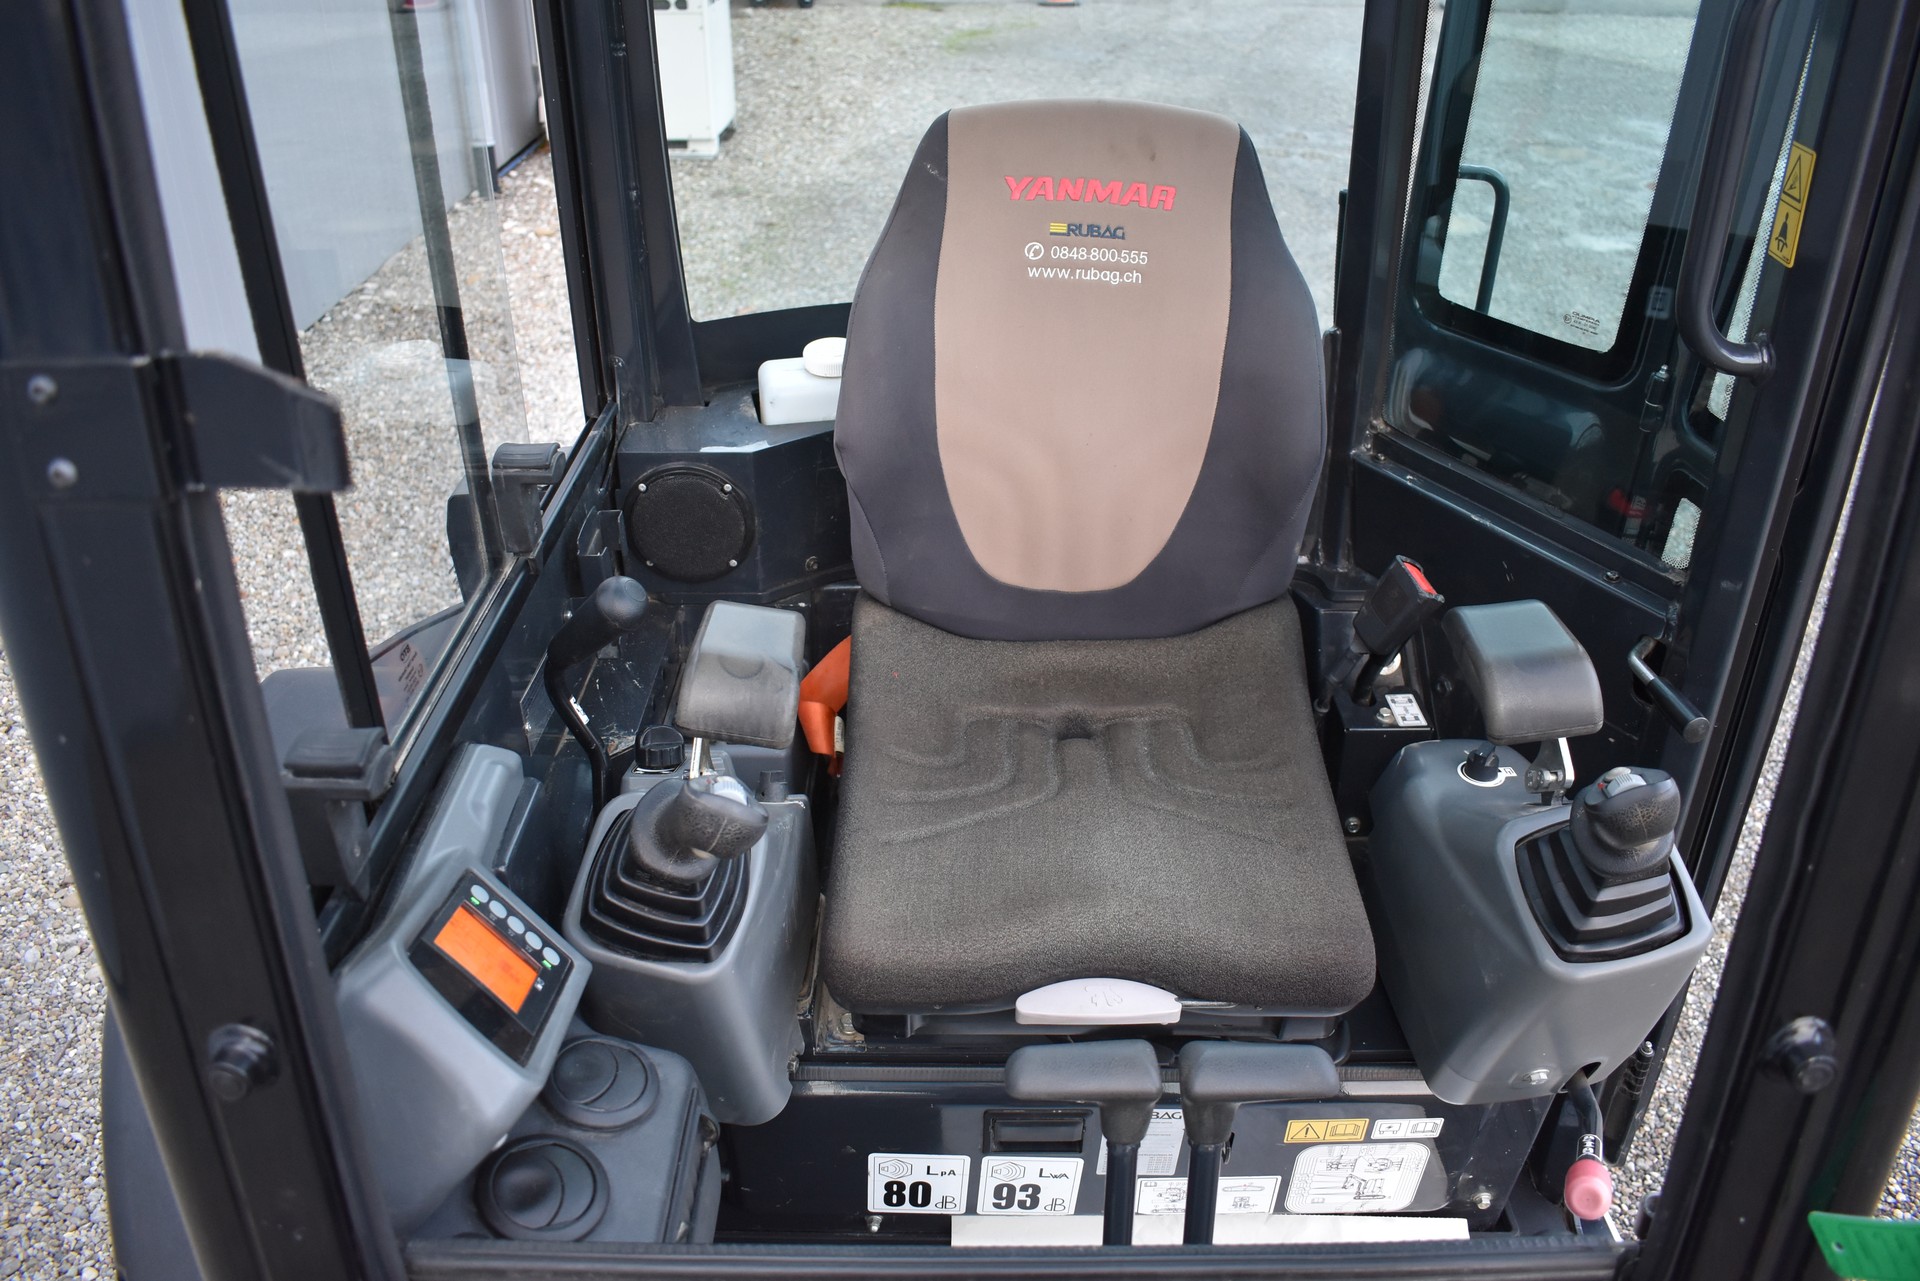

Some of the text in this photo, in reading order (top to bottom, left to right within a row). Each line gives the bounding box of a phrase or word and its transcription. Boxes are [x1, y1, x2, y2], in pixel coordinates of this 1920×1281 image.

[1004, 175, 1177, 211] YANMAR
[1066, 223, 1126, 240] RUBAG
[1027, 266, 1142, 284] www.rubag.ch
[1151, 1112, 1182, 1120] BAG
[883, 1180, 957, 1210] 80 dB
[992, 1183, 1066, 1212] 93 dB
